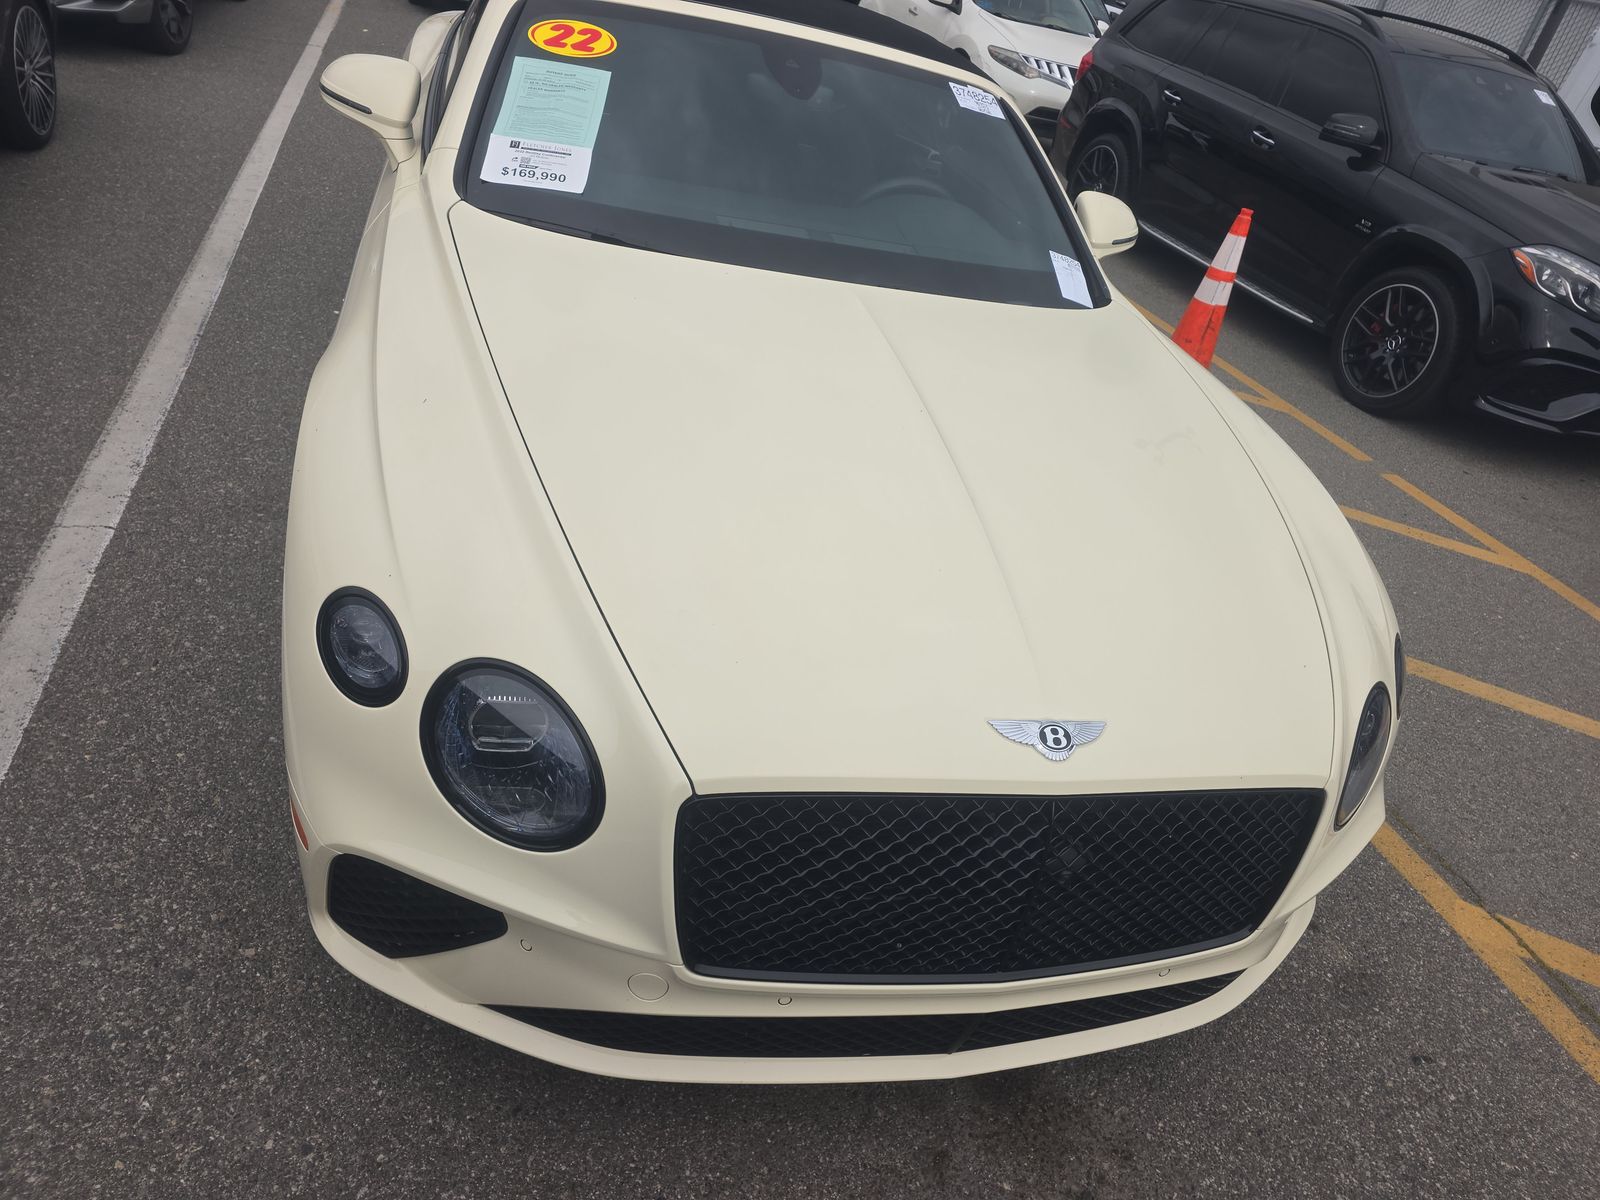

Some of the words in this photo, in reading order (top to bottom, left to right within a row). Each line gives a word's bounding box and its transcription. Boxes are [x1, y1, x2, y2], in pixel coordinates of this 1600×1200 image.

[543, 24, 602, 52] 22
[501, 166, 567, 183] $169,990
[1043, 727, 1068, 749] B
